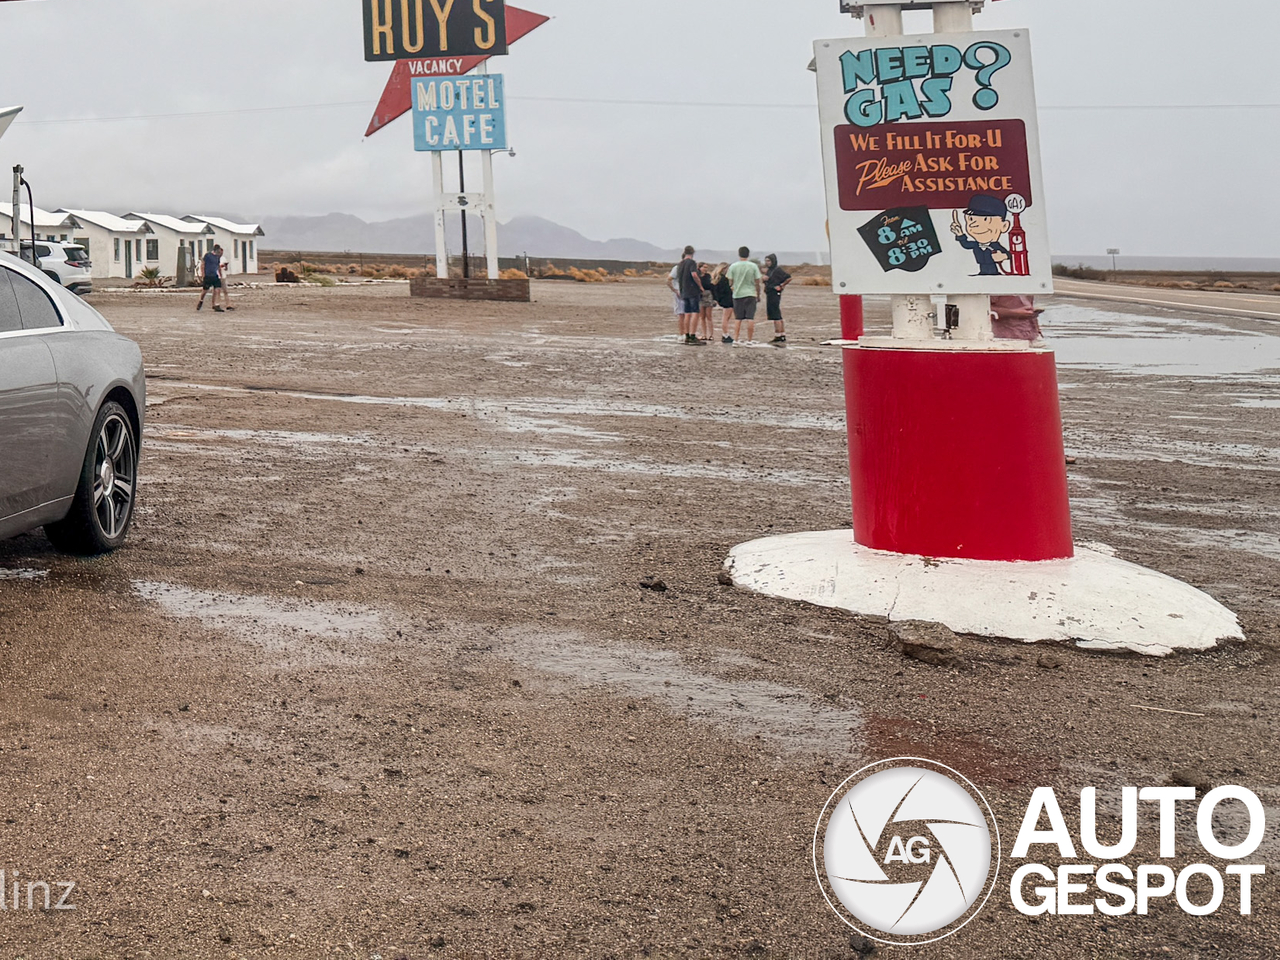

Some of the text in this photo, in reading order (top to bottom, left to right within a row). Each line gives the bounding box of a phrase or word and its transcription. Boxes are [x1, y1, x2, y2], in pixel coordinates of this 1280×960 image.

[408, 58, 463, 75] VACANCY
[839, 44, 963, 94] NEED
[416, 78, 500, 112] MOTEL
[843, 75, 954, 128] GAS
[424, 113, 494, 146] CAFE
[855, 156, 913, 196] Please
[901, 175, 1014, 192] ASSISTANCE
[1007, 198, 1024, 210] GAS
[877, 224, 923, 244] 8 AM
[910, 245, 933, 259] PM
